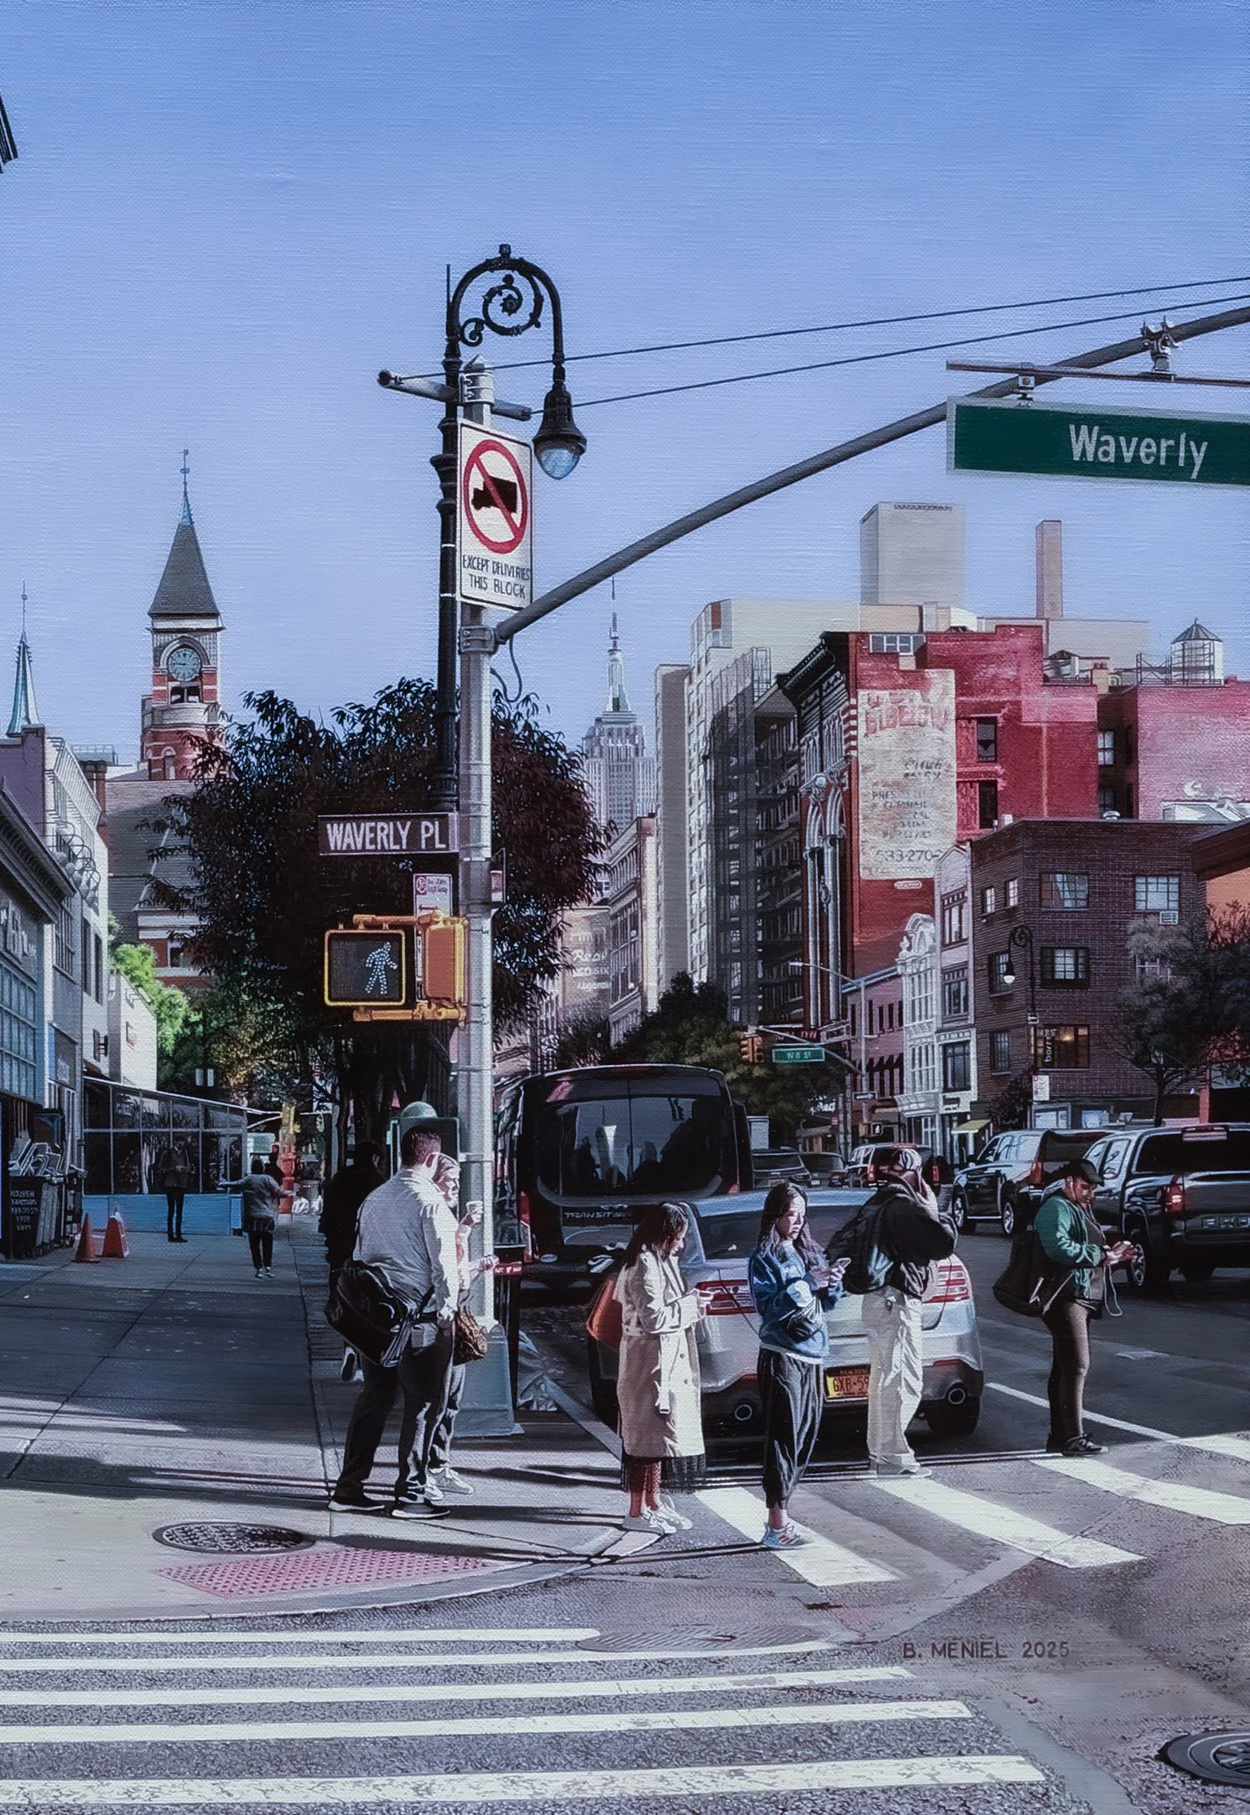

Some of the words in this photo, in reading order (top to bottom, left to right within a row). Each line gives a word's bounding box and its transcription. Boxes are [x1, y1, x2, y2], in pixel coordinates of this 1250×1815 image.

[1069, 424, 1208, 479] Waverly
[463, 554, 490, 573] EXCEPT
[492, 561, 530, 581] DELIVERIES
[469, 573, 488, 590] THIS
[493, 579, 526, 599] BLOCK
[326, 821, 410, 851] WAVERLY
[421, 820, 447, 849] PL
[876, 848, 942, 863] 533-270
[902, 1641, 922, 1659] B.
[931, 1641, 1008, 1659] MENIEL
[1022, 1641, 1070, 1658] 2025
